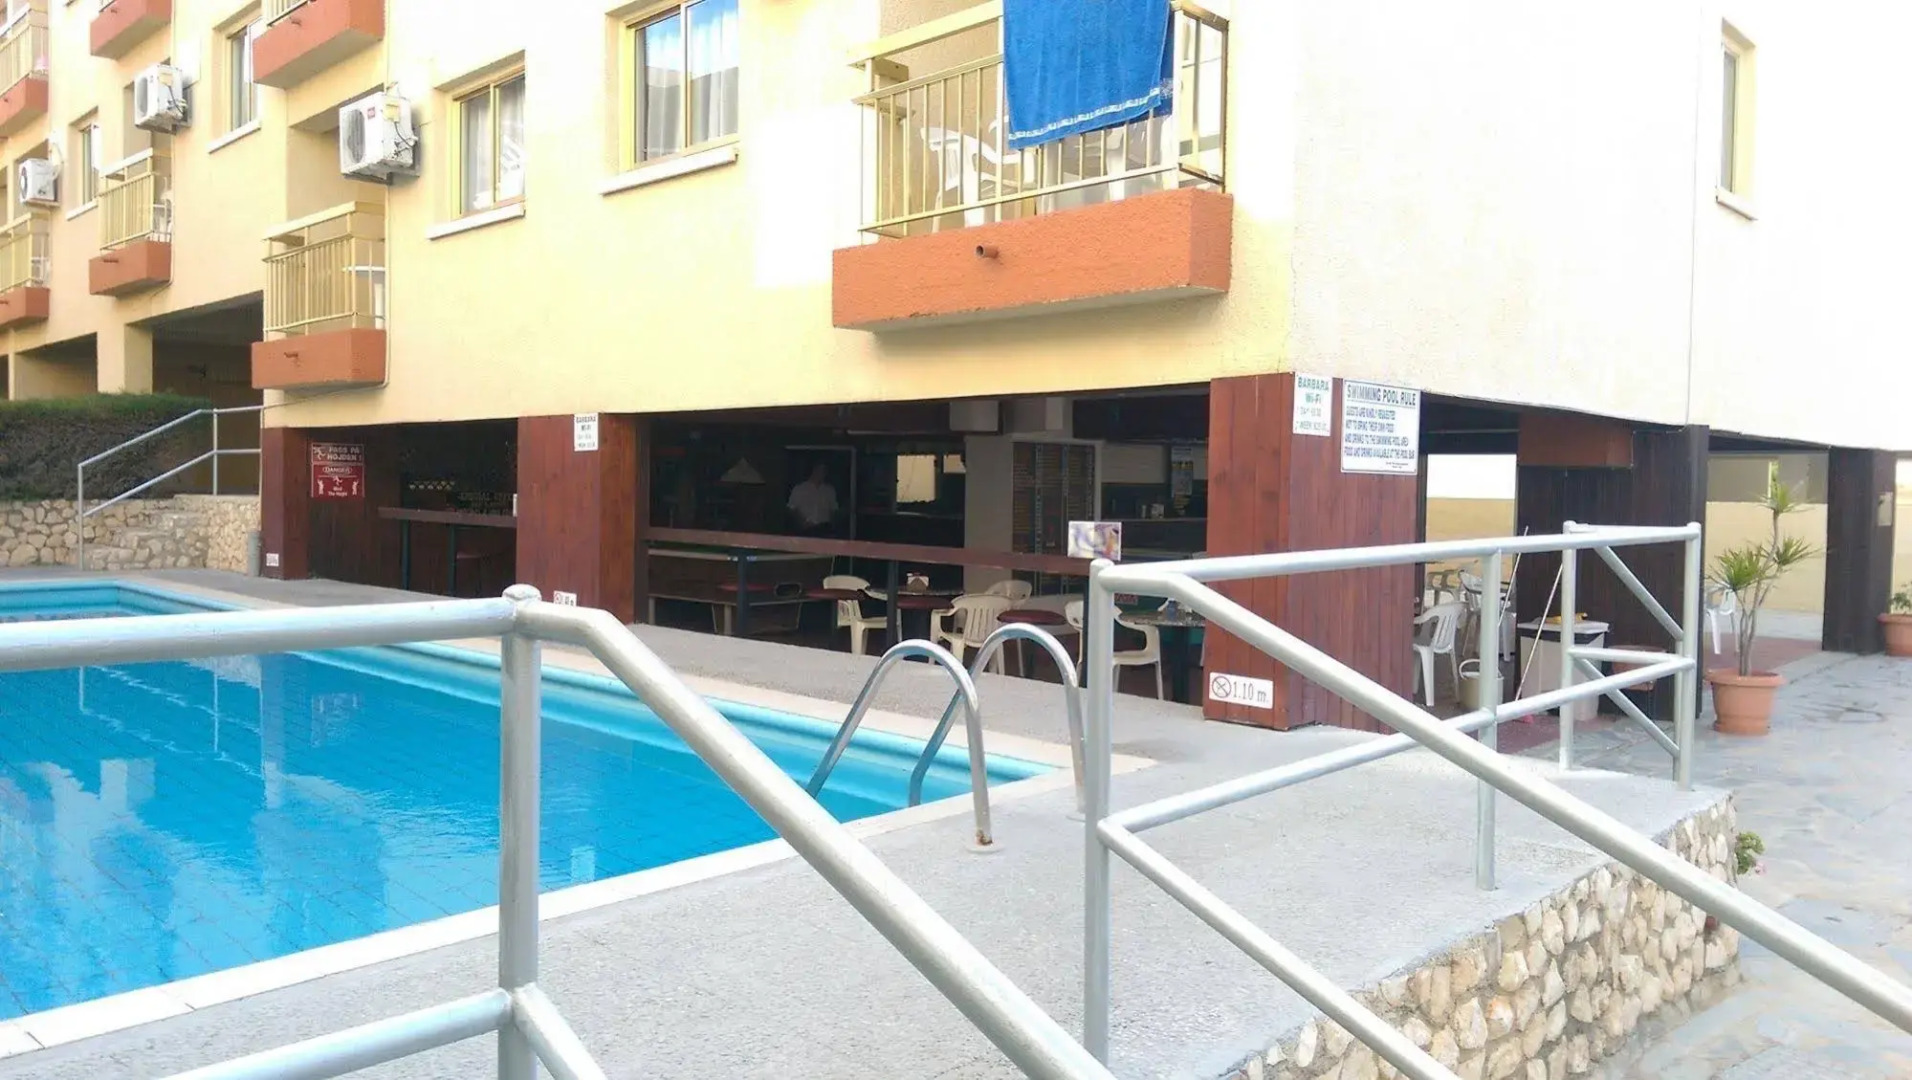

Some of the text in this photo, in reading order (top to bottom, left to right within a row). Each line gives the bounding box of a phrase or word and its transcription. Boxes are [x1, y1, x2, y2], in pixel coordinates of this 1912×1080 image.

[1298, 376, 1329, 391] BARBARA
[1347, 384, 1416, 406] SWIMMING POOL RULE
[1233, 681, 1267, 703] 1.10 m
